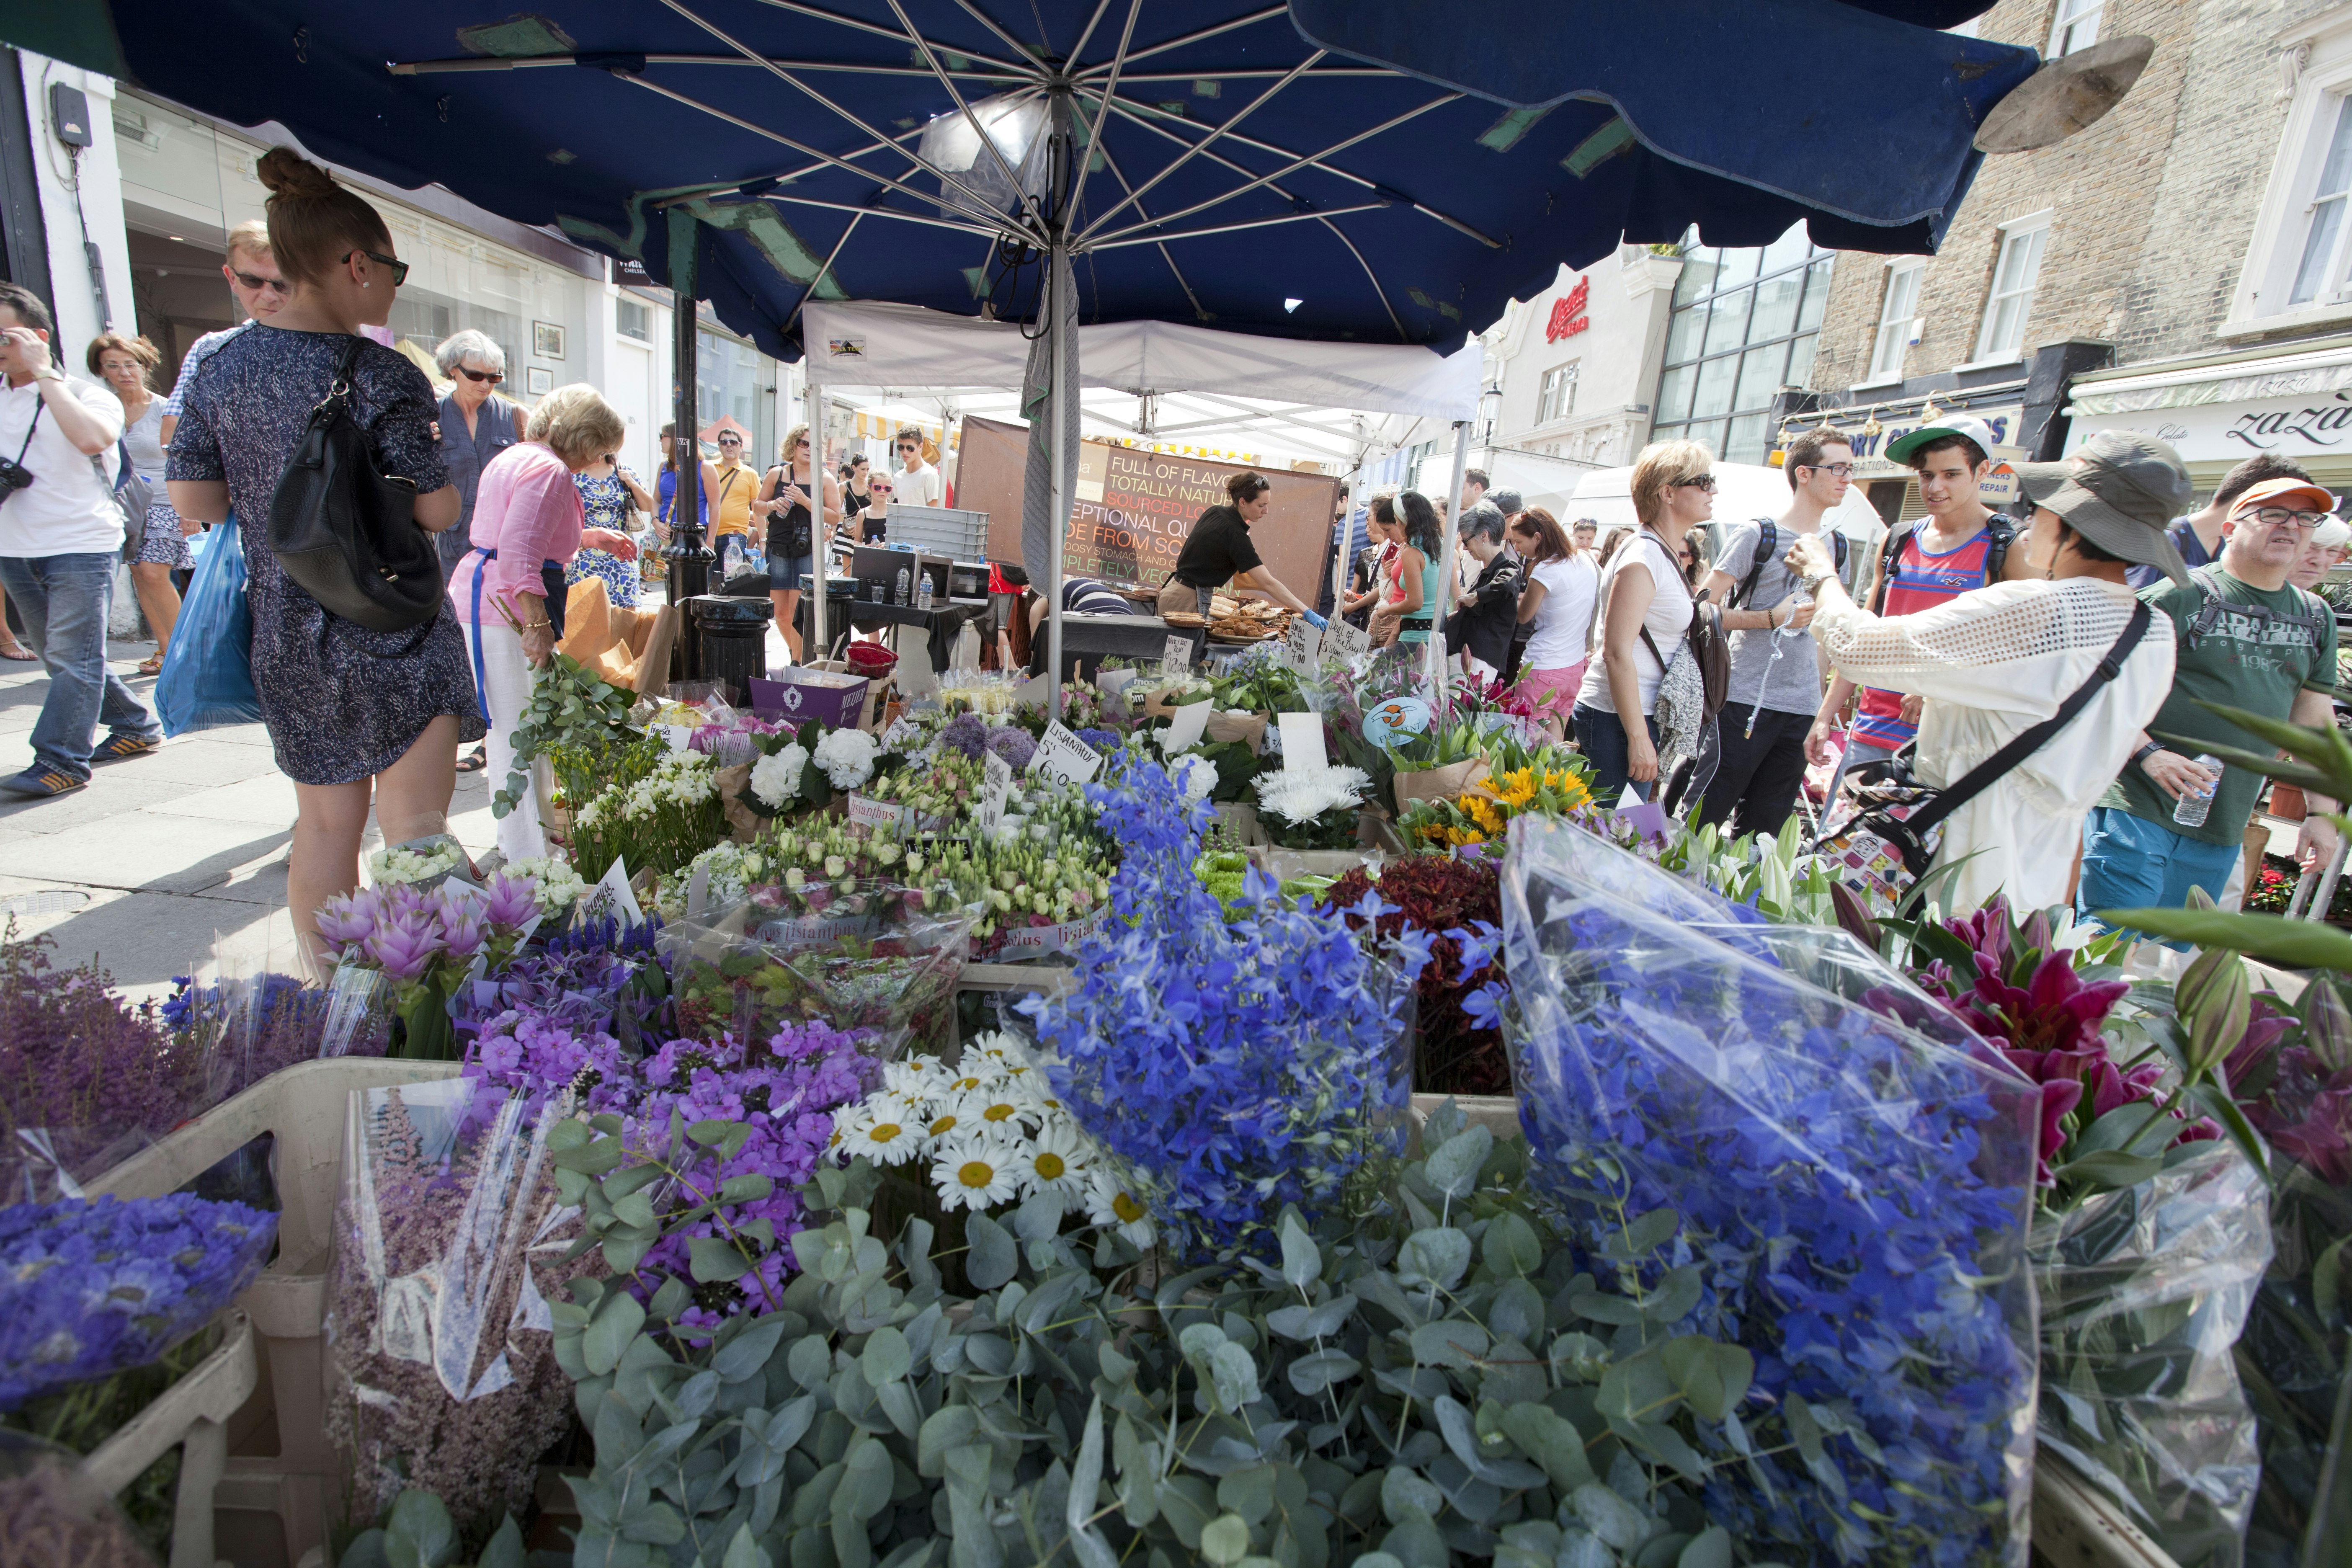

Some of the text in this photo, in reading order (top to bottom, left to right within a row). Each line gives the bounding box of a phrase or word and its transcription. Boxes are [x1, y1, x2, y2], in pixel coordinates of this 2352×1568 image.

[1112, 456, 1151, 476] FULL
[1156, 464, 1179, 480] OF
[1110, 474, 1177, 498] TOTALLY
[1979, 482, 2008, 493] REPAIR
[1106, 492, 1182, 516] SOURCED
[1070, 502, 1162, 534] EPTIONAL
[1092, 526, 1150, 551] FROM
[1064, 542, 1092, 554] OOSY
[1094, 547, 1143, 563] STOMACH
[1144, 555, 1167, 566] AND
[1329, 616, 1355, 641] Deal of
[1335, 634, 1345, 645] The
[1286, 634, 1292, 647] 5
[1321, 640, 1330, 652] 5
[2241, 654, 2284, 671] 1987
[840, 687, 866, 710] MEIJER
[849, 799, 895, 820] Lisianthus
